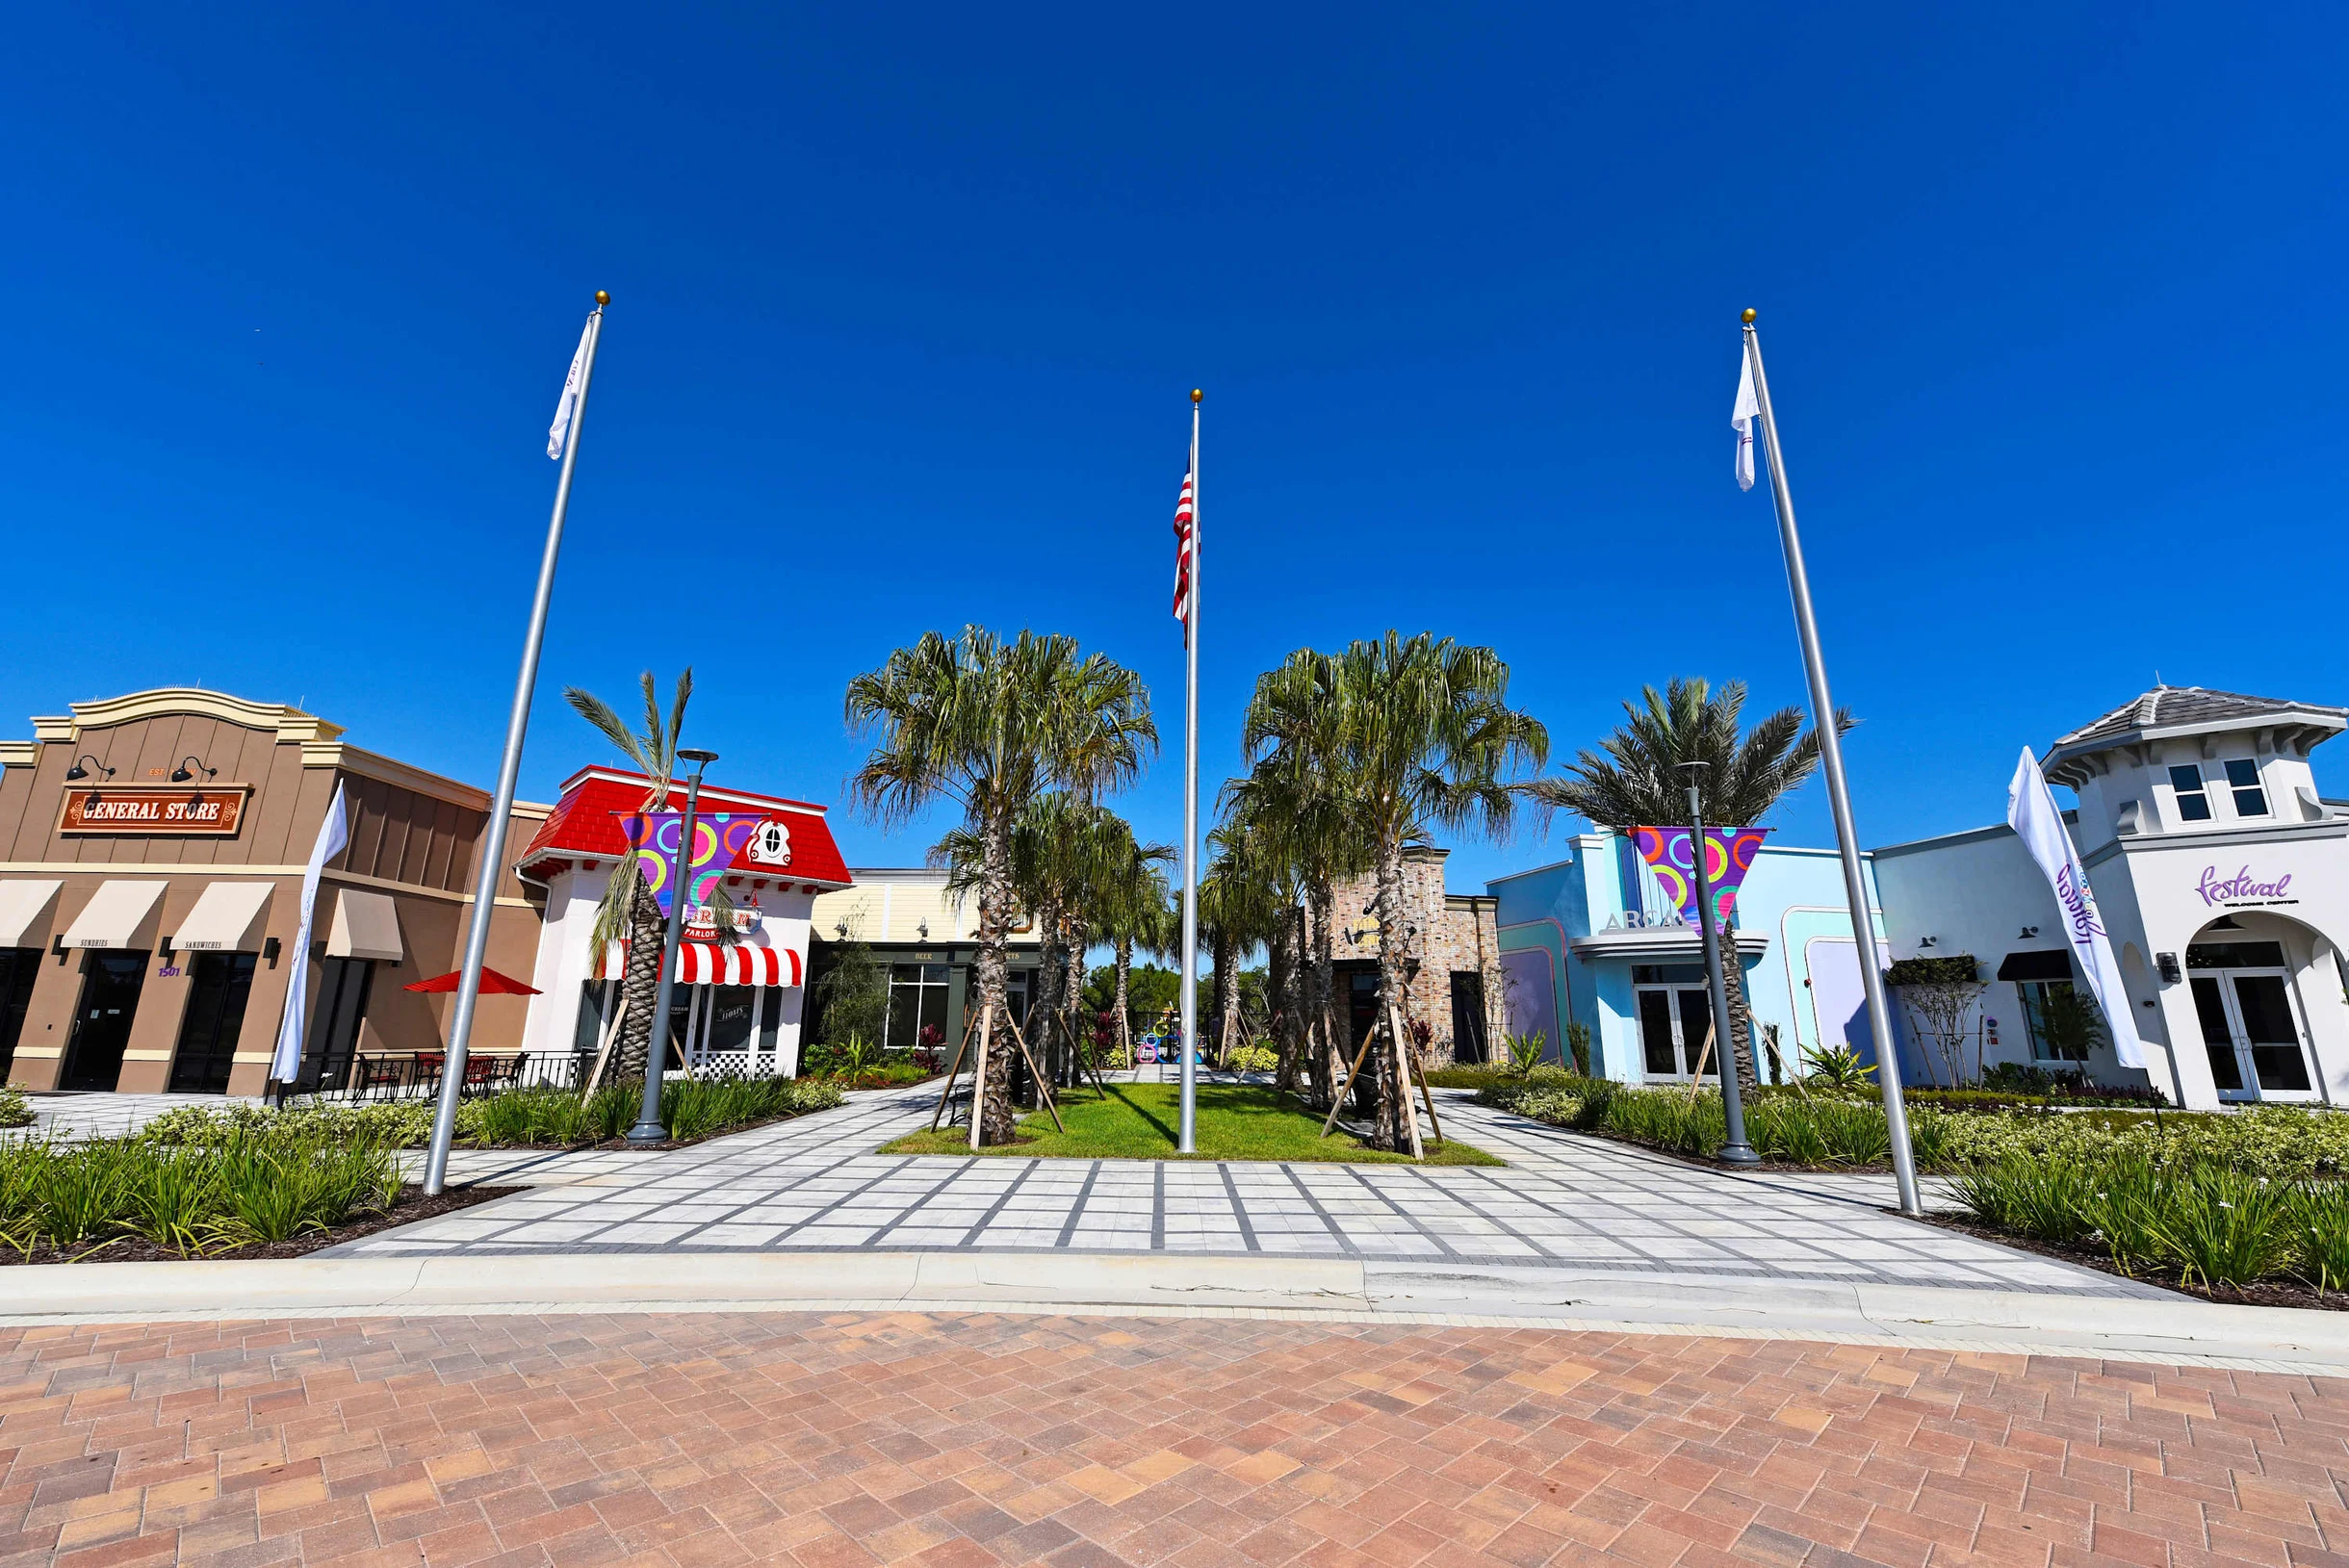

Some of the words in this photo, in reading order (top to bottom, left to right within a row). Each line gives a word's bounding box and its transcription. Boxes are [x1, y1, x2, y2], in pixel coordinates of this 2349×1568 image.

[83, 802, 161, 820] GENERAL
[165, 802, 220, 820] STORE
[2195, 864, 2292, 907] festival
[1605, 910, 1687, 930] ARCA
[684, 928, 716, 938] PARLOR
[80, 938, 109, 947] SUNDRIES
[185, 940, 222, 949] SANDWICHES
[158, 966, 181, 977] 1501
